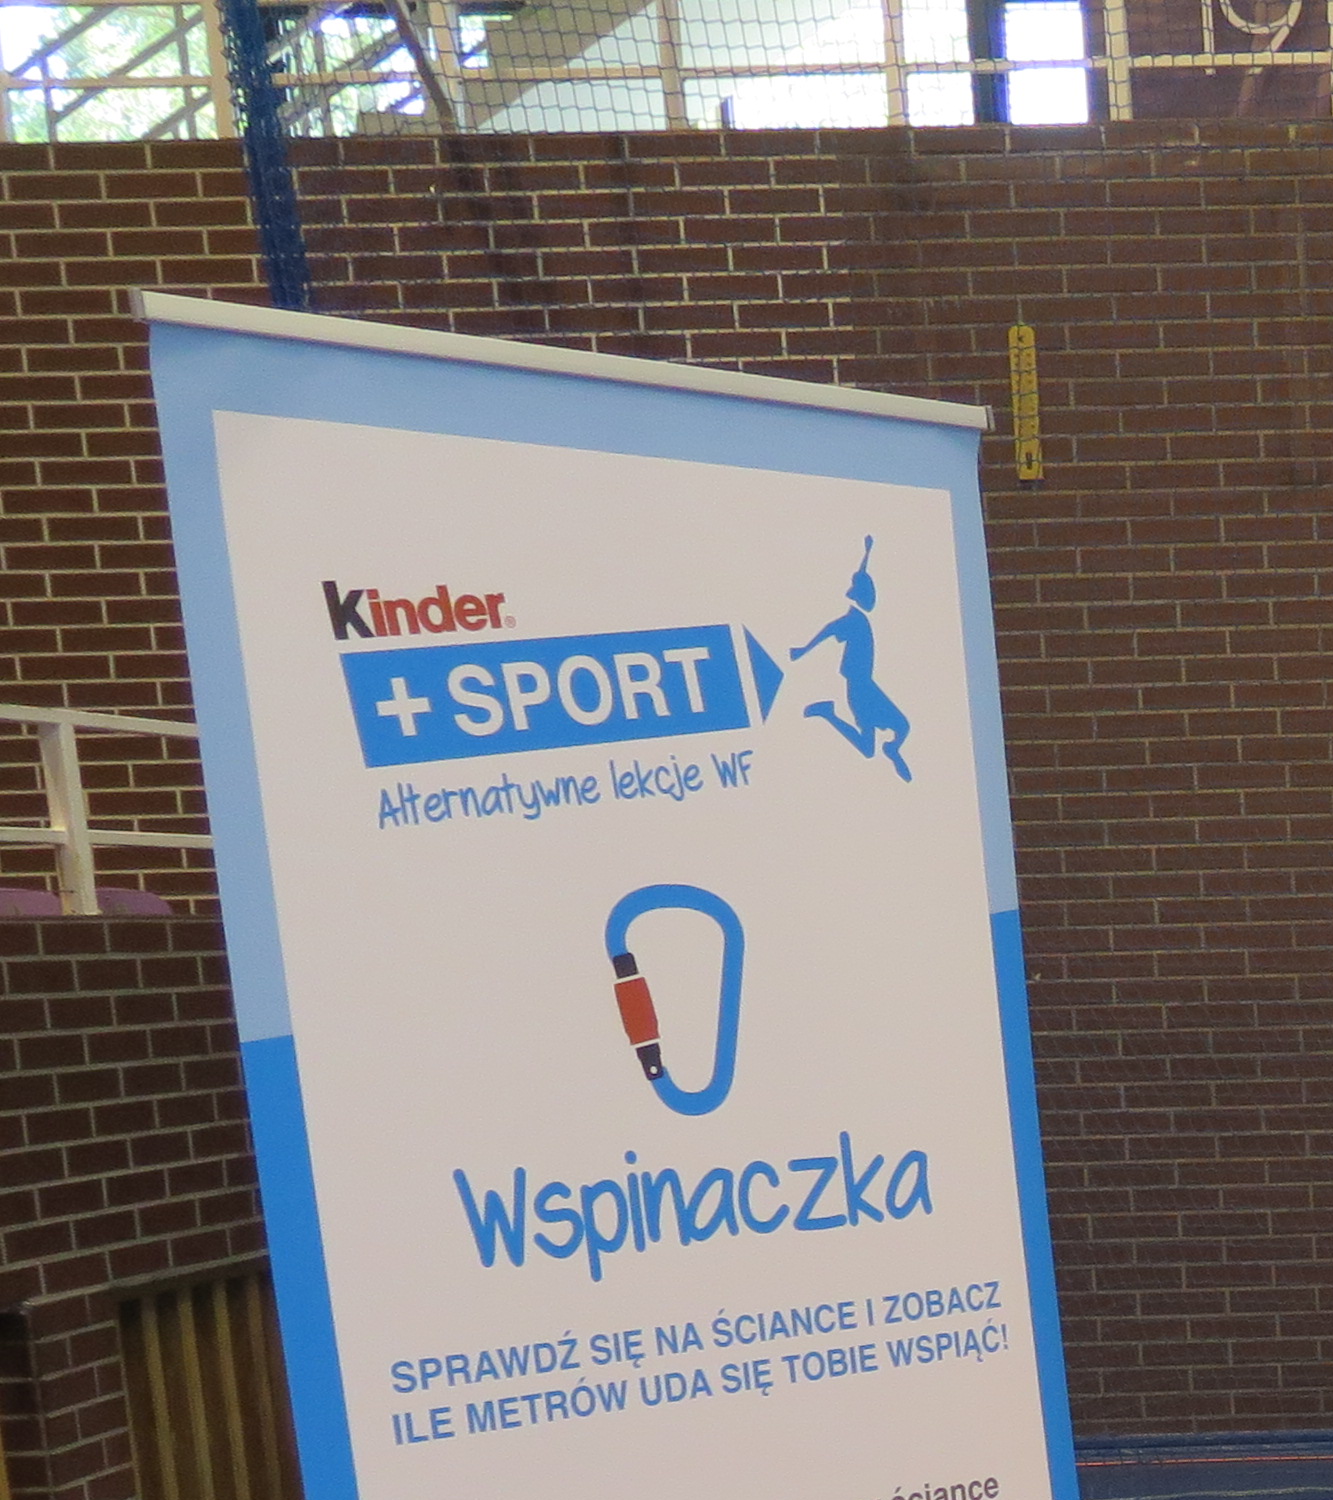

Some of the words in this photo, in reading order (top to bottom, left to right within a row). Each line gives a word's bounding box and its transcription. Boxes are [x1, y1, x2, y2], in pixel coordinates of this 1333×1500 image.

[446, 647, 711, 738] SPORT
[378, 771, 602, 830] Alternatywne
[609, 757, 704, 802] lekcje
[710, 749, 754, 789] WF
[452, 1131, 934, 1282] Wspinaczka
[391, 1330, 580, 1394] SPRAWDŹ
[589, 1329, 646, 1369] SIĘ
[655, 1322, 704, 1356] NA
[711, 1301, 858, 1348] ŚCIANCE
[866, 1299, 875, 1326] I
[882, 1281, 1001, 1325] ZOBACZ
[391, 1406, 456, 1446] ILE
[465, 1376, 628, 1435] METRÓW
[638, 1368, 714, 1407] UDA
[720, 1358, 775, 1397] SIĘ
[780, 1343, 879, 1384] TOBIE
[885, 1318, 1009, 1368] WSPIĄĆ!
